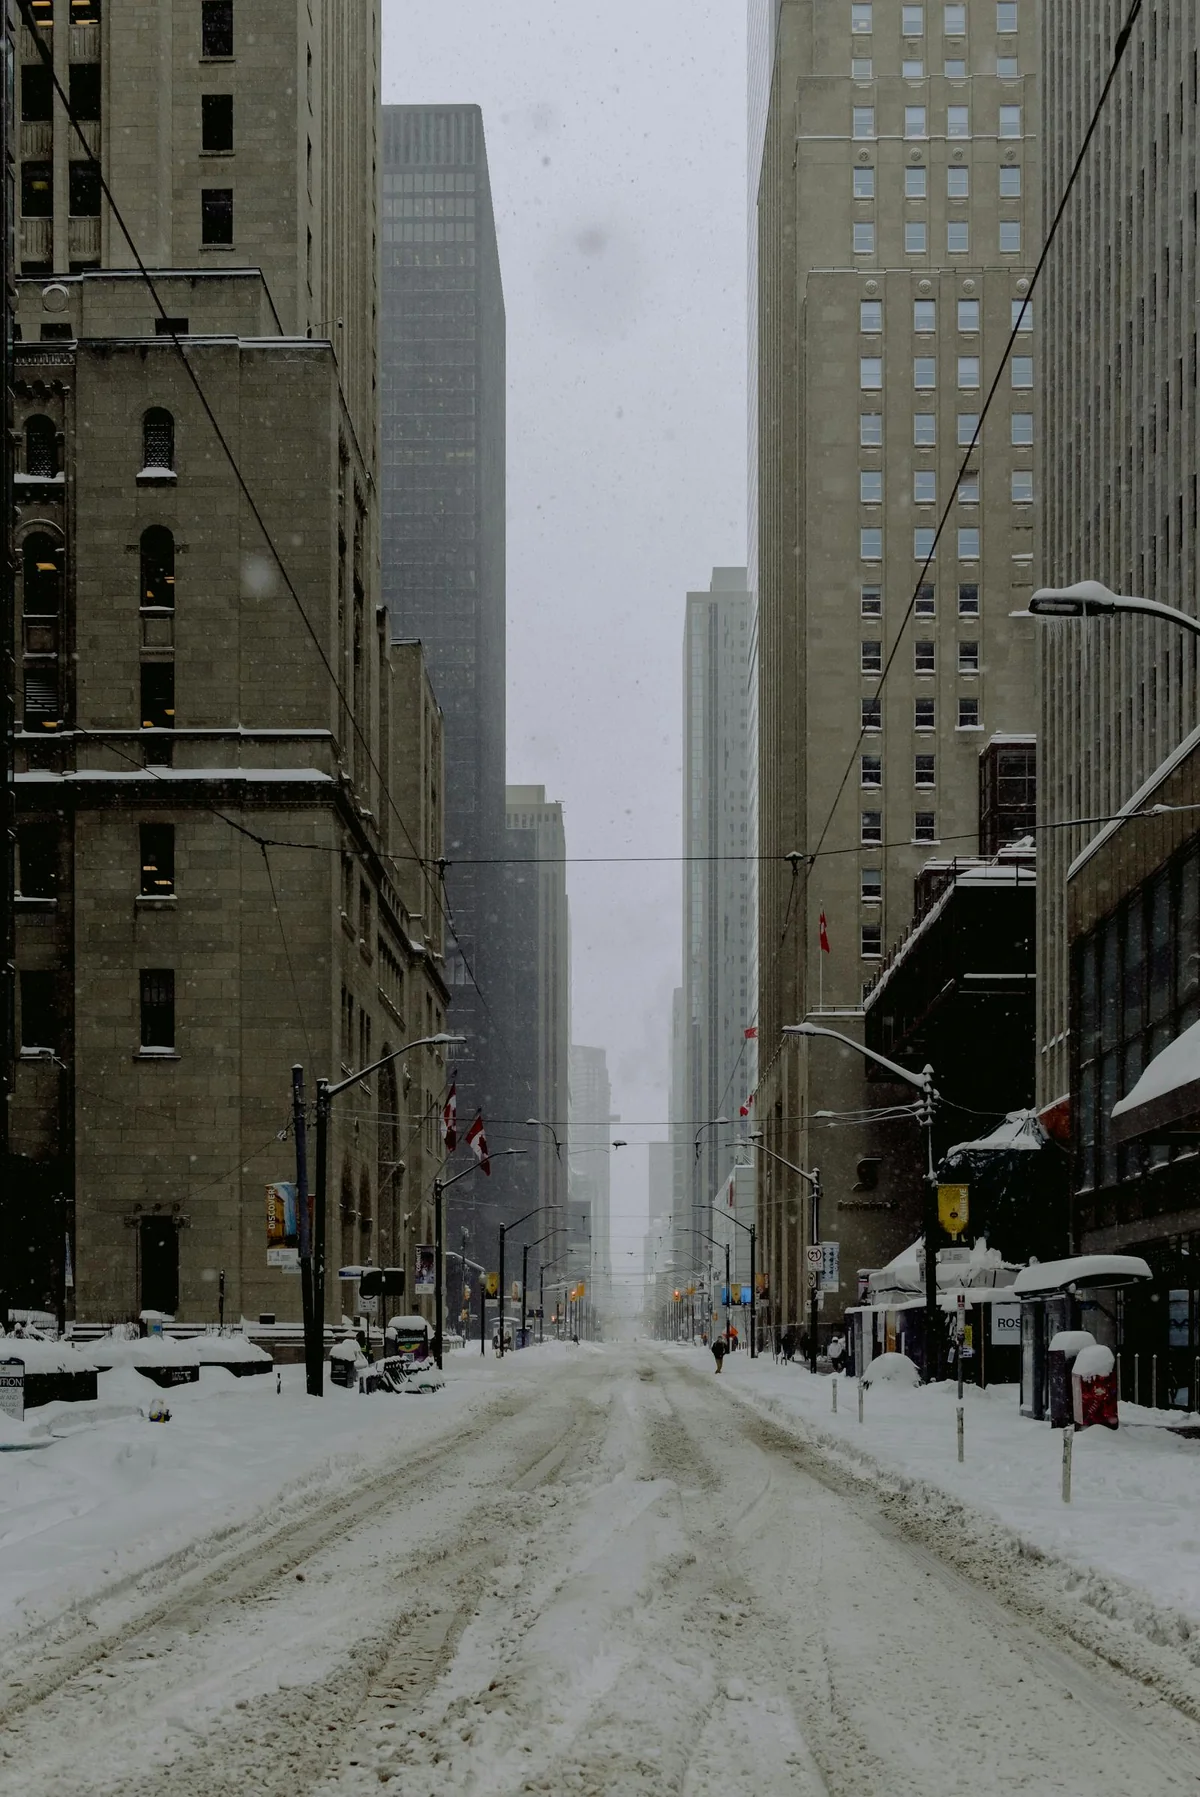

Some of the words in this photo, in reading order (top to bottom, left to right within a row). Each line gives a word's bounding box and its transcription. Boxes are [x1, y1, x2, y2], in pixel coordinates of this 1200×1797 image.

[268, 1187, 276, 1229] DISCOVER
[960, 1187, 968, 1222] ACHIEVE
[0, 1378, 22, 1386] TION
